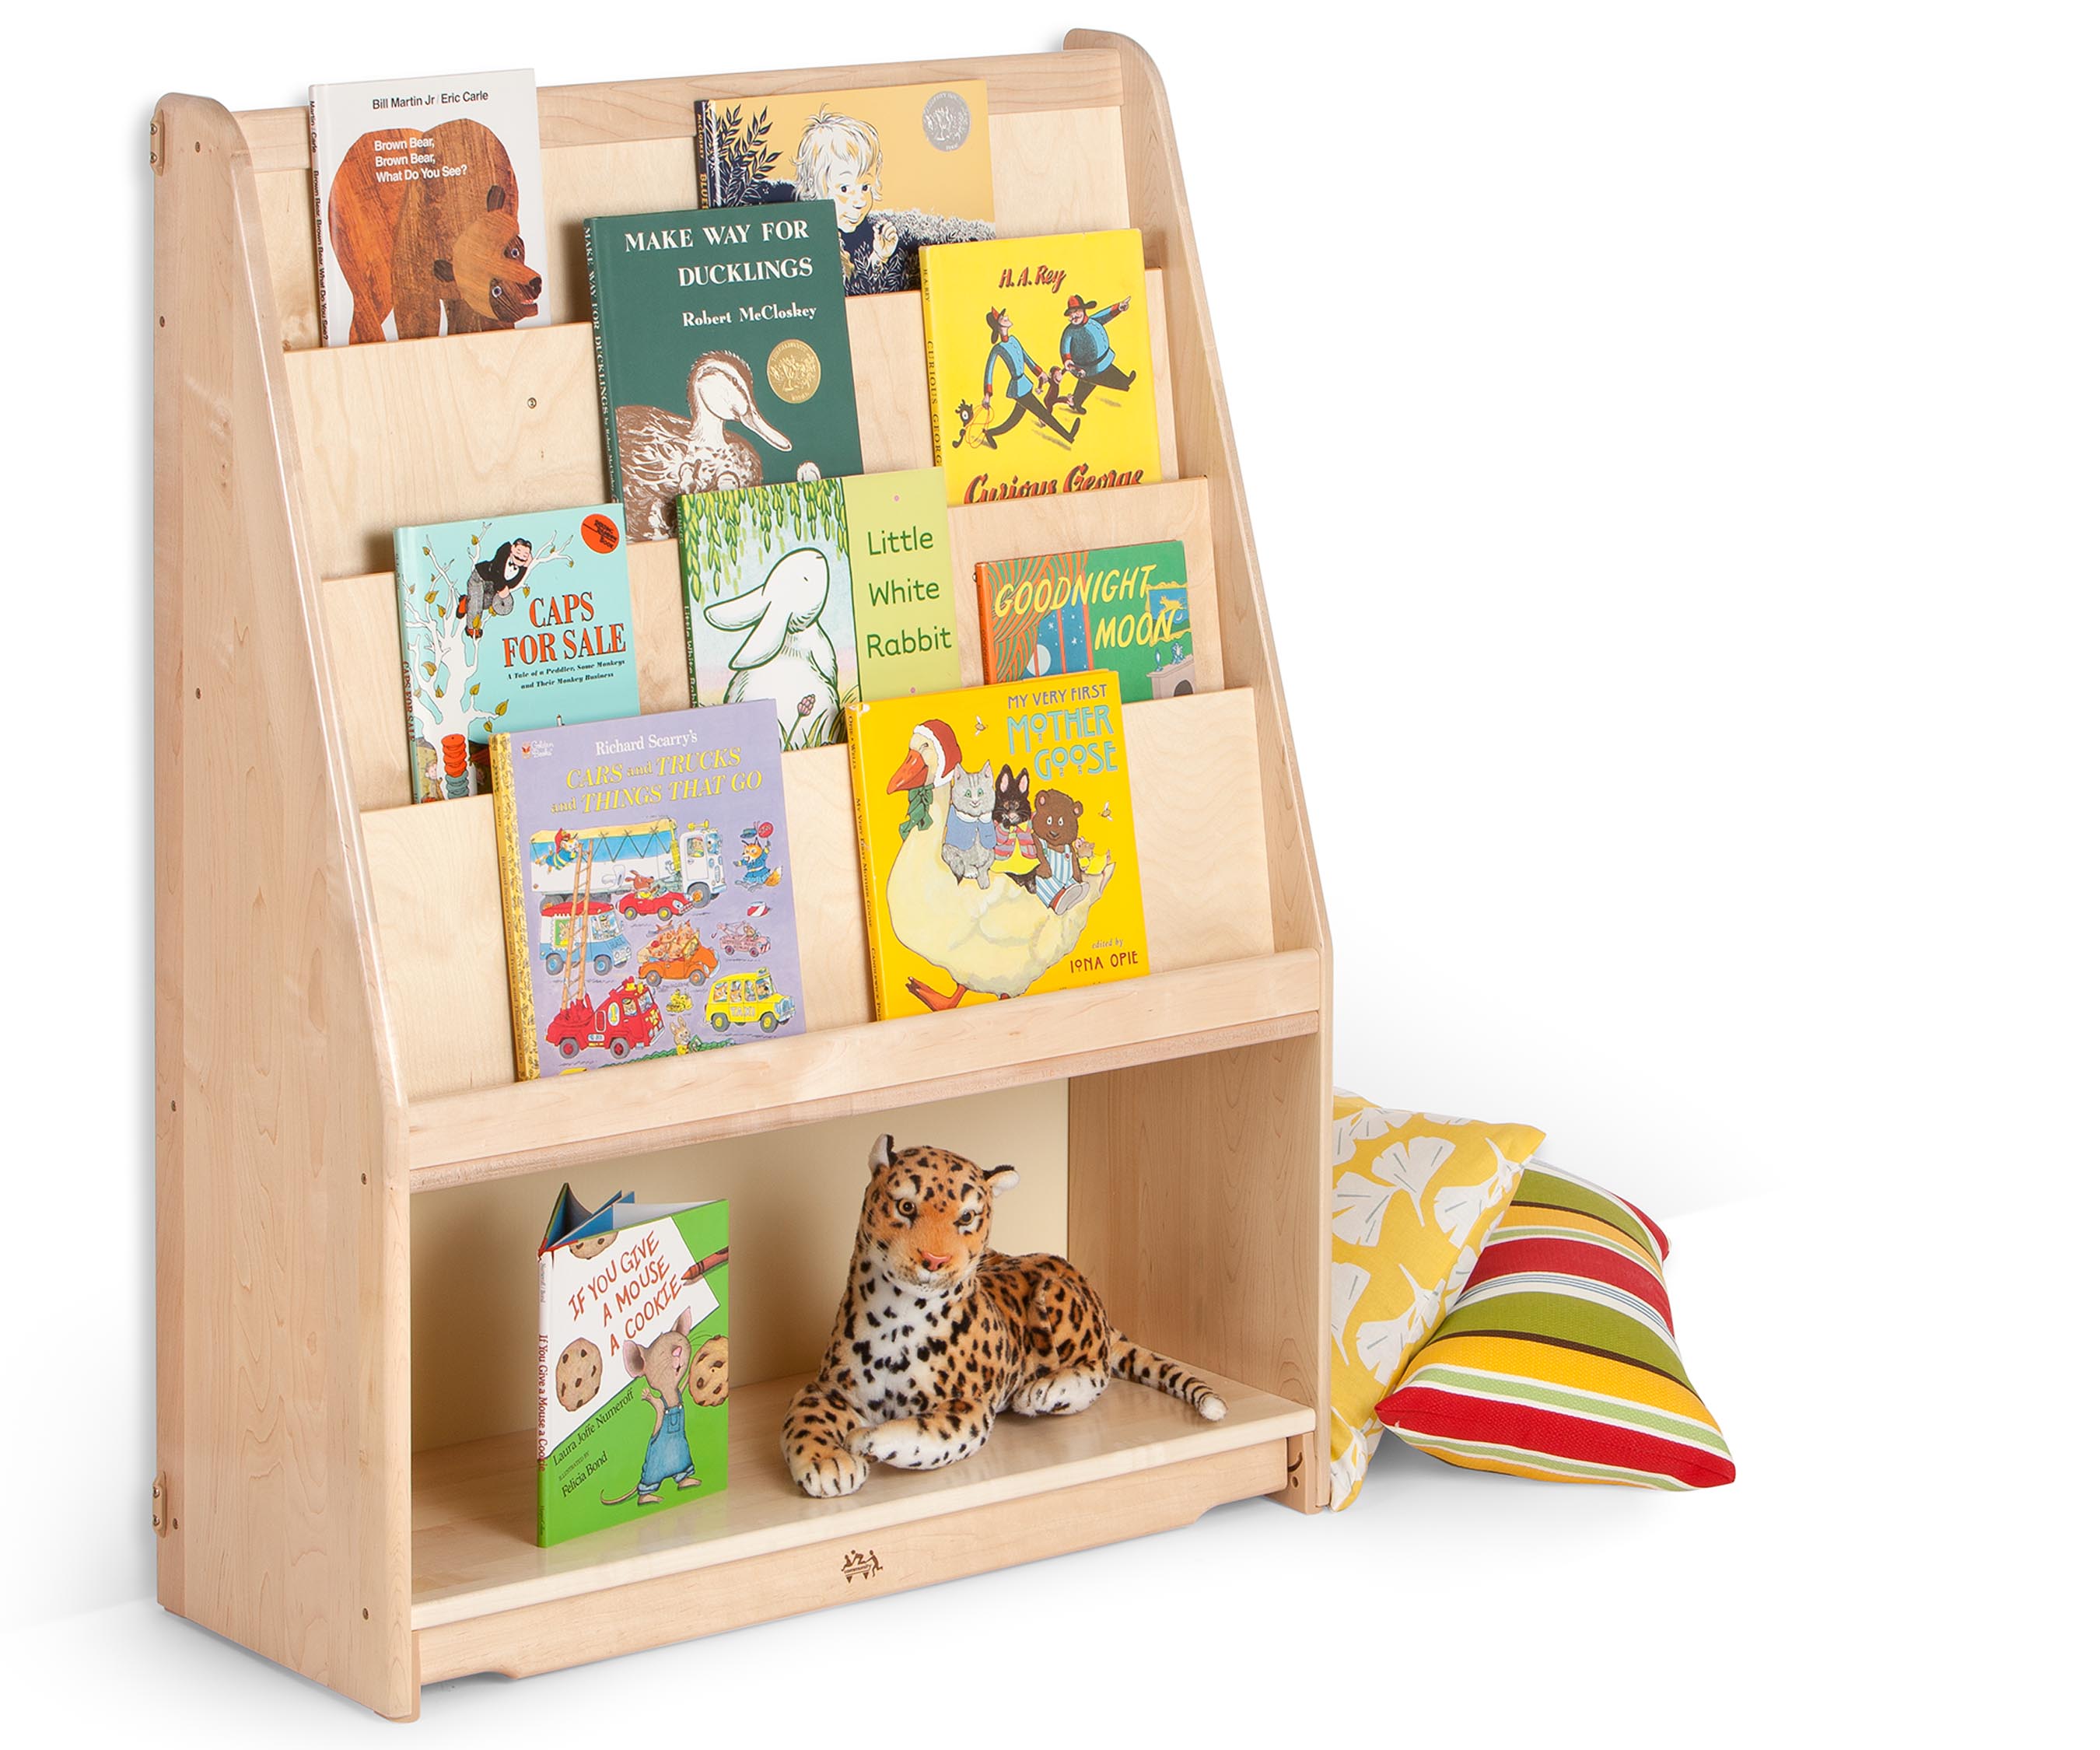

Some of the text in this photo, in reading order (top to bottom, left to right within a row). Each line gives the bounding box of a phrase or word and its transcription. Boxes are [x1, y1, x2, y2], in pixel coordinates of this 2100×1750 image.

[373, 90, 488, 109] Bill Martin Jr Eric Carle
[374, 137, 435, 151] Brown Bear,
[375, 152, 436, 167] Brown Bear,
[376, 164, 467, 183] What Do You See?
[625, 219, 810, 252] MAKE WAY FOR
[677, 257, 814, 287] DUCKLINGS
[999, 264, 1066, 294] H. A. Rey
[320, 289, 327, 302] Do
[584, 227, 593, 265] MAKE
[589, 271, 597, 298] WAY
[595, 336, 608, 415] DUCKLINGS
[682, 302, 817, 327] Robert McCloskey
[928, 341, 938, 404] CURIOUS
[867, 525, 934, 556] Little
[868, 578, 940, 607] White
[995, 564, 1157, 618] GOODNIGHT
[529, 591, 594, 628] CAPS
[502, 623, 626, 667] FOR SALE
[866, 625, 952, 659] Rabbit
[1094, 609, 1177, 650] MOON
[537, 679, 555, 688] Their
[557, 676, 583, 685] Monkey
[585, 672, 614, 681] Business
[546, 666, 576, 675] Peddler,
[597, 660, 625, 668] Monkeys
[402, 661, 415, 741] CAPS FOR SALE
[1008, 684, 1107, 709] MY VERY FIRST
[595, 729, 698, 757] Richard Scarry's
[1007, 705, 1114, 754] MOTHER
[566, 747, 741, 789] CARS and TRUCKS
[1034, 740, 1118, 781] GOOSE
[551, 770, 762, 814] and THINGS THAT GO
[1092, 936, 1123, 949] edited by
[1070, 950, 1139, 974] IONA OPIE
[730, 1006, 755, 1017] TAXI
[568, 1230, 660, 1321] IF YOU GIVE
[603, 1255, 670, 1328] A MOUSE
[610, 1273, 682, 1356] A COOKIE
[538, 1335, 548, 1343] If
[538, 1344, 548, 1364] You
[538, 1365, 548, 1387] Give
[538, 1396, 548, 1429] Mouse
[553, 1388, 635, 1467] Laura Joffe Numeroff
[537, 1438, 548, 1472] Cookie
[562, 1450, 608, 1498] Felicia Bond
